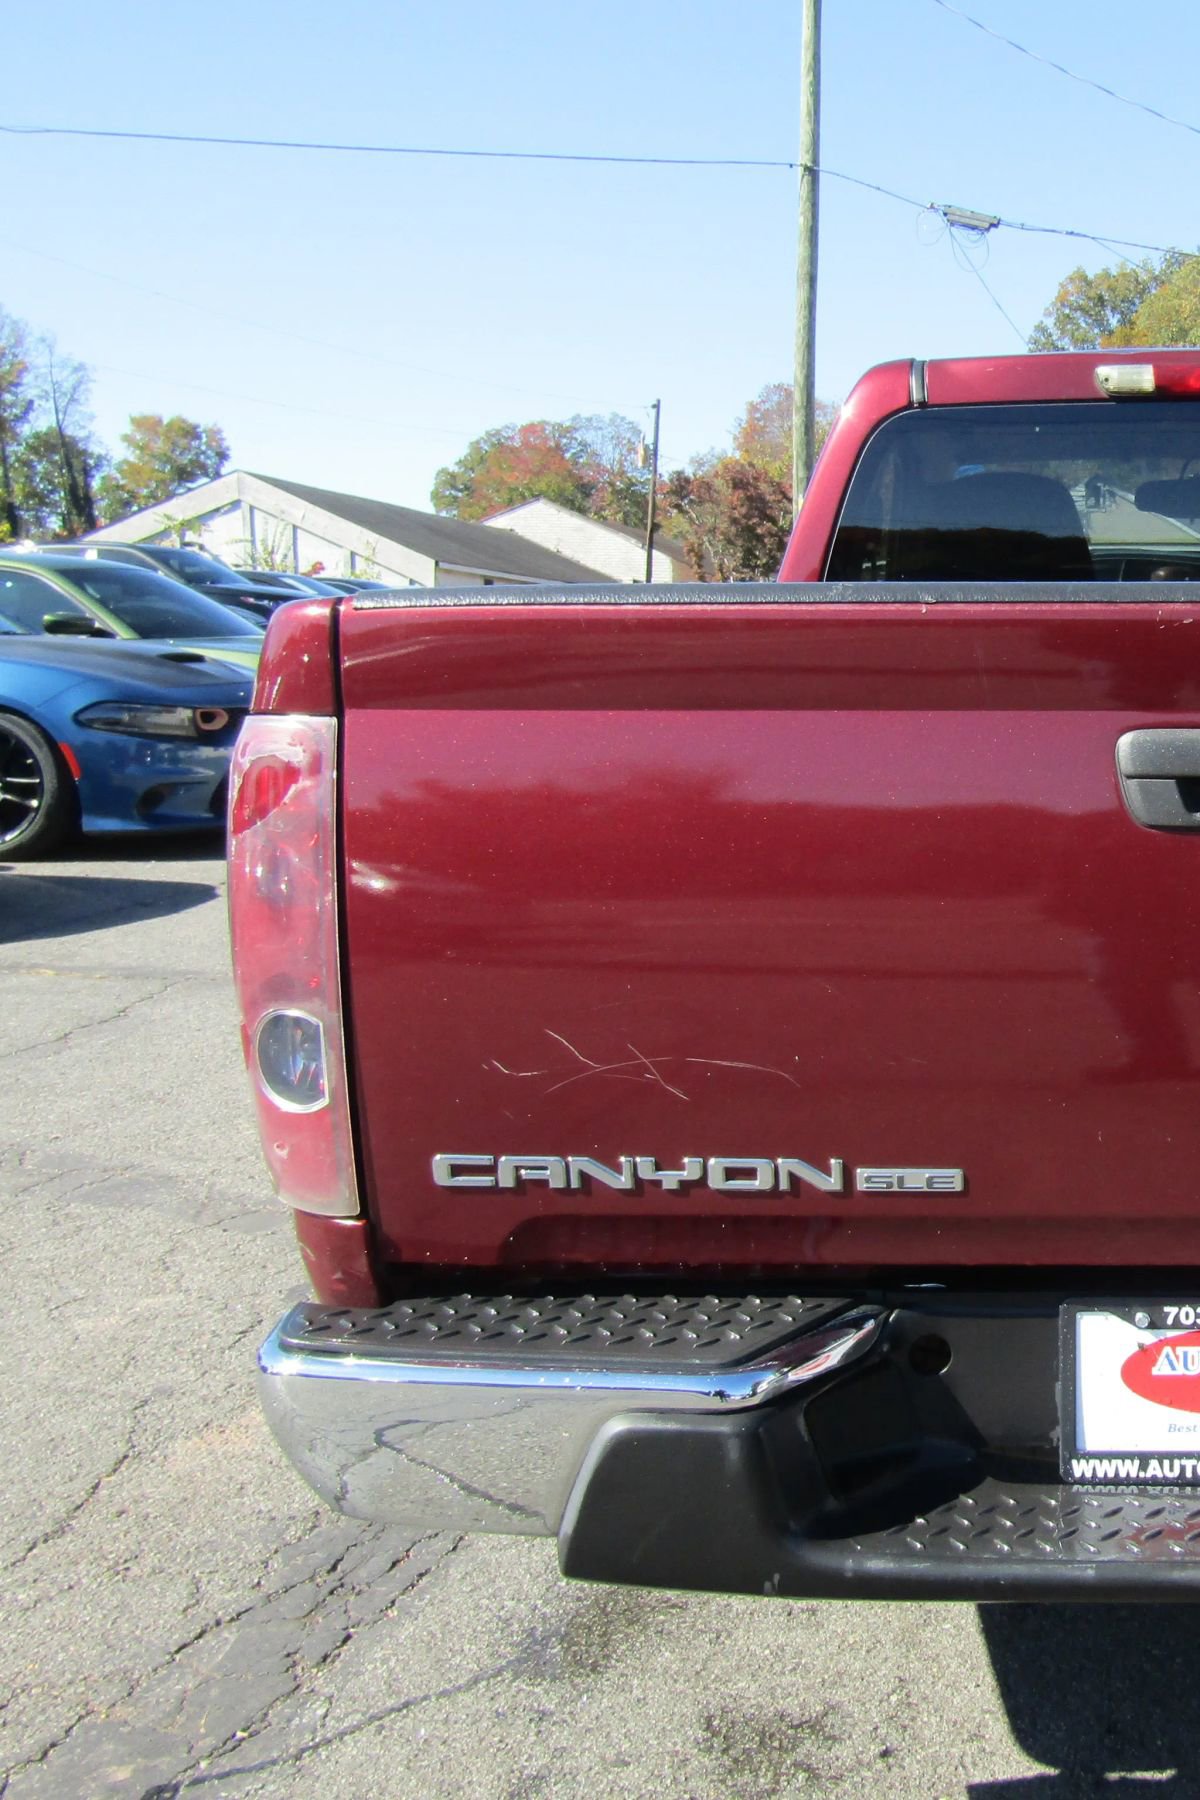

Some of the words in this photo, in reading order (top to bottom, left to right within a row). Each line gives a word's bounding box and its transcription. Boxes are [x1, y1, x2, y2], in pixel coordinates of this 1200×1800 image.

[432, 1153, 844, 1192] CANYON
[860, 1171, 959, 1191] SLE
[1167, 1422, 1198, 1434] Best
